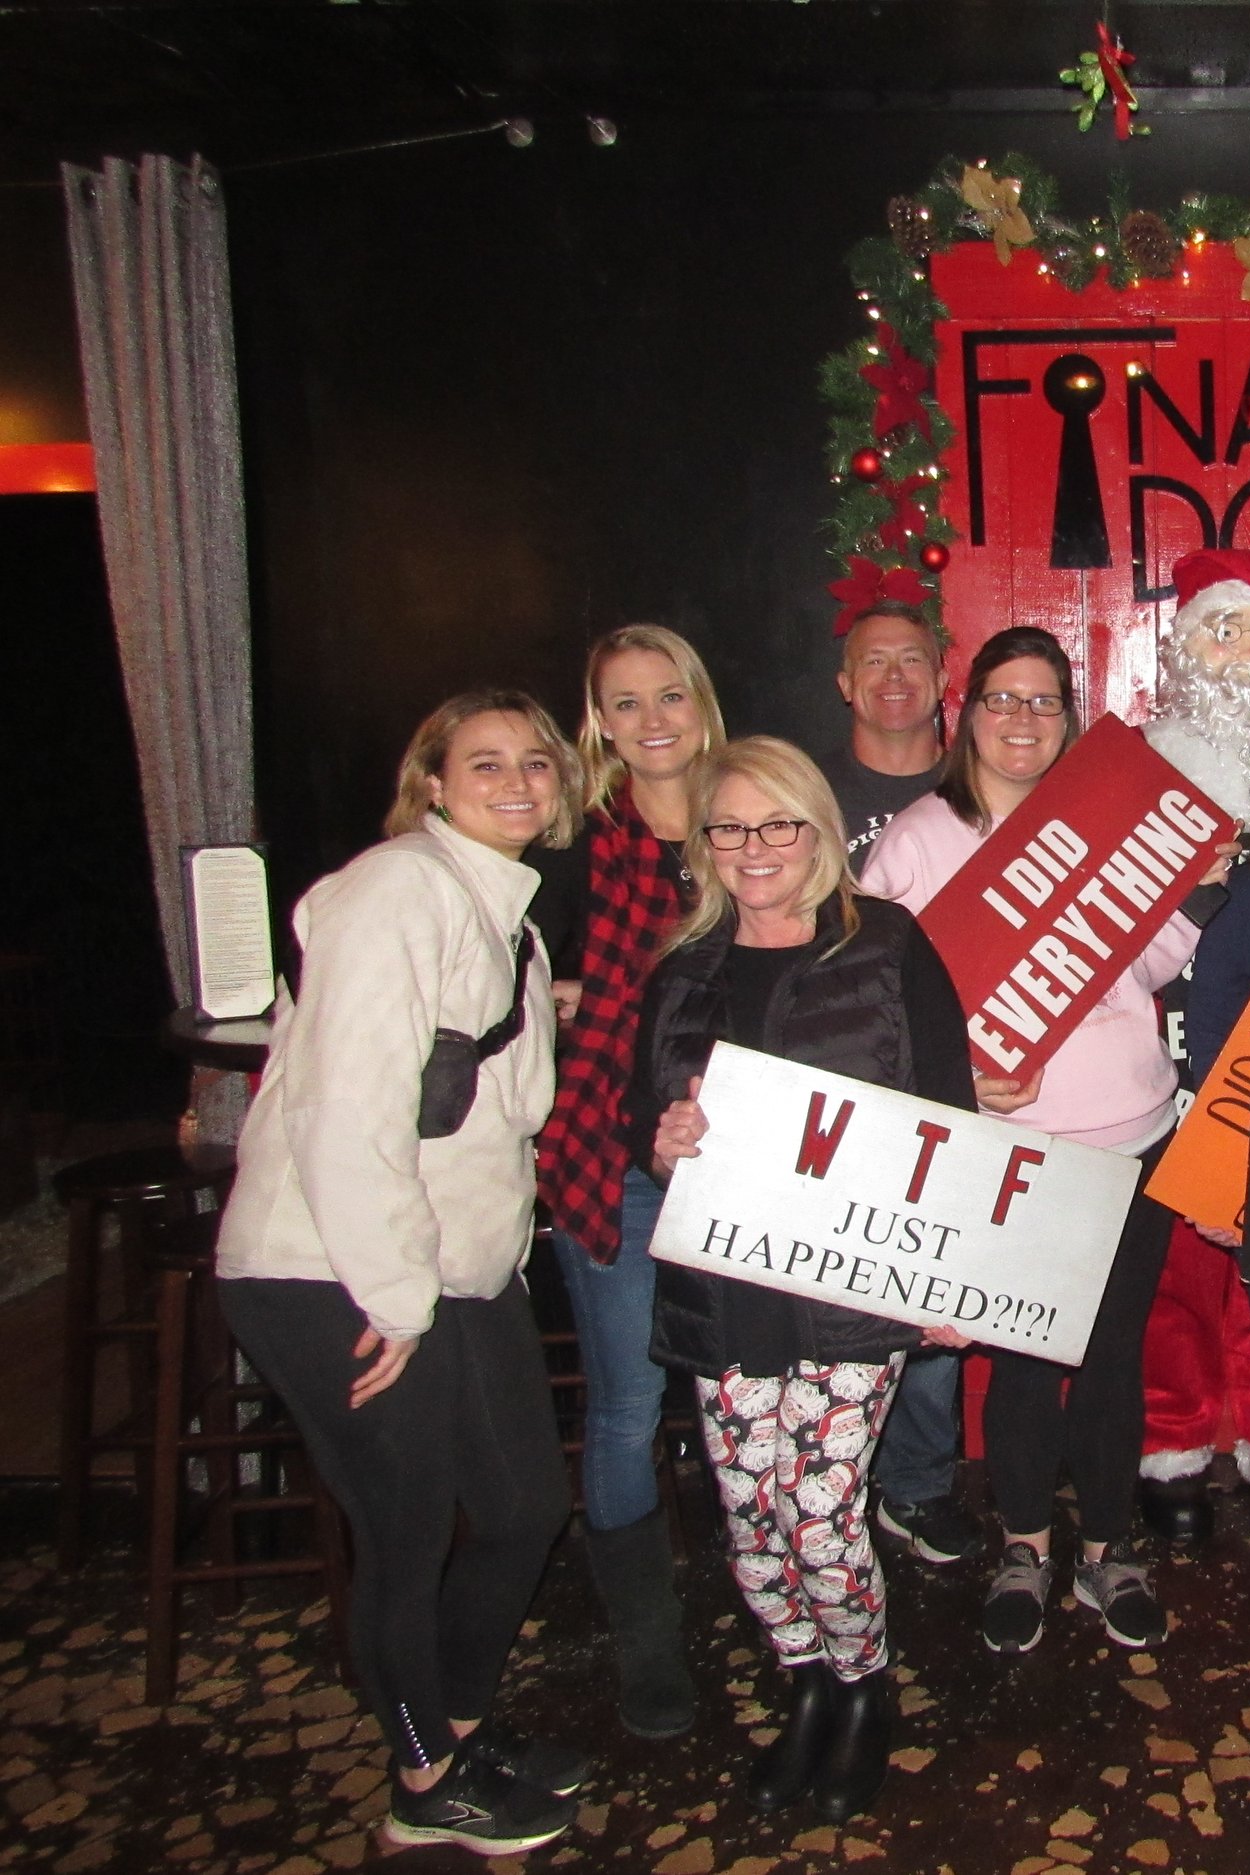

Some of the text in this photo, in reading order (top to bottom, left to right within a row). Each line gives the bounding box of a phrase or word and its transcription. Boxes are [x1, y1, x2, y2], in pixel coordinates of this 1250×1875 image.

[967, 789, 1219, 1074] EVERYTHING
[982, 819, 1089, 930] I DID
[699, 1218, 1058, 1342] HAPPENED?!?!
[833, 1201, 961, 1261] JUST
